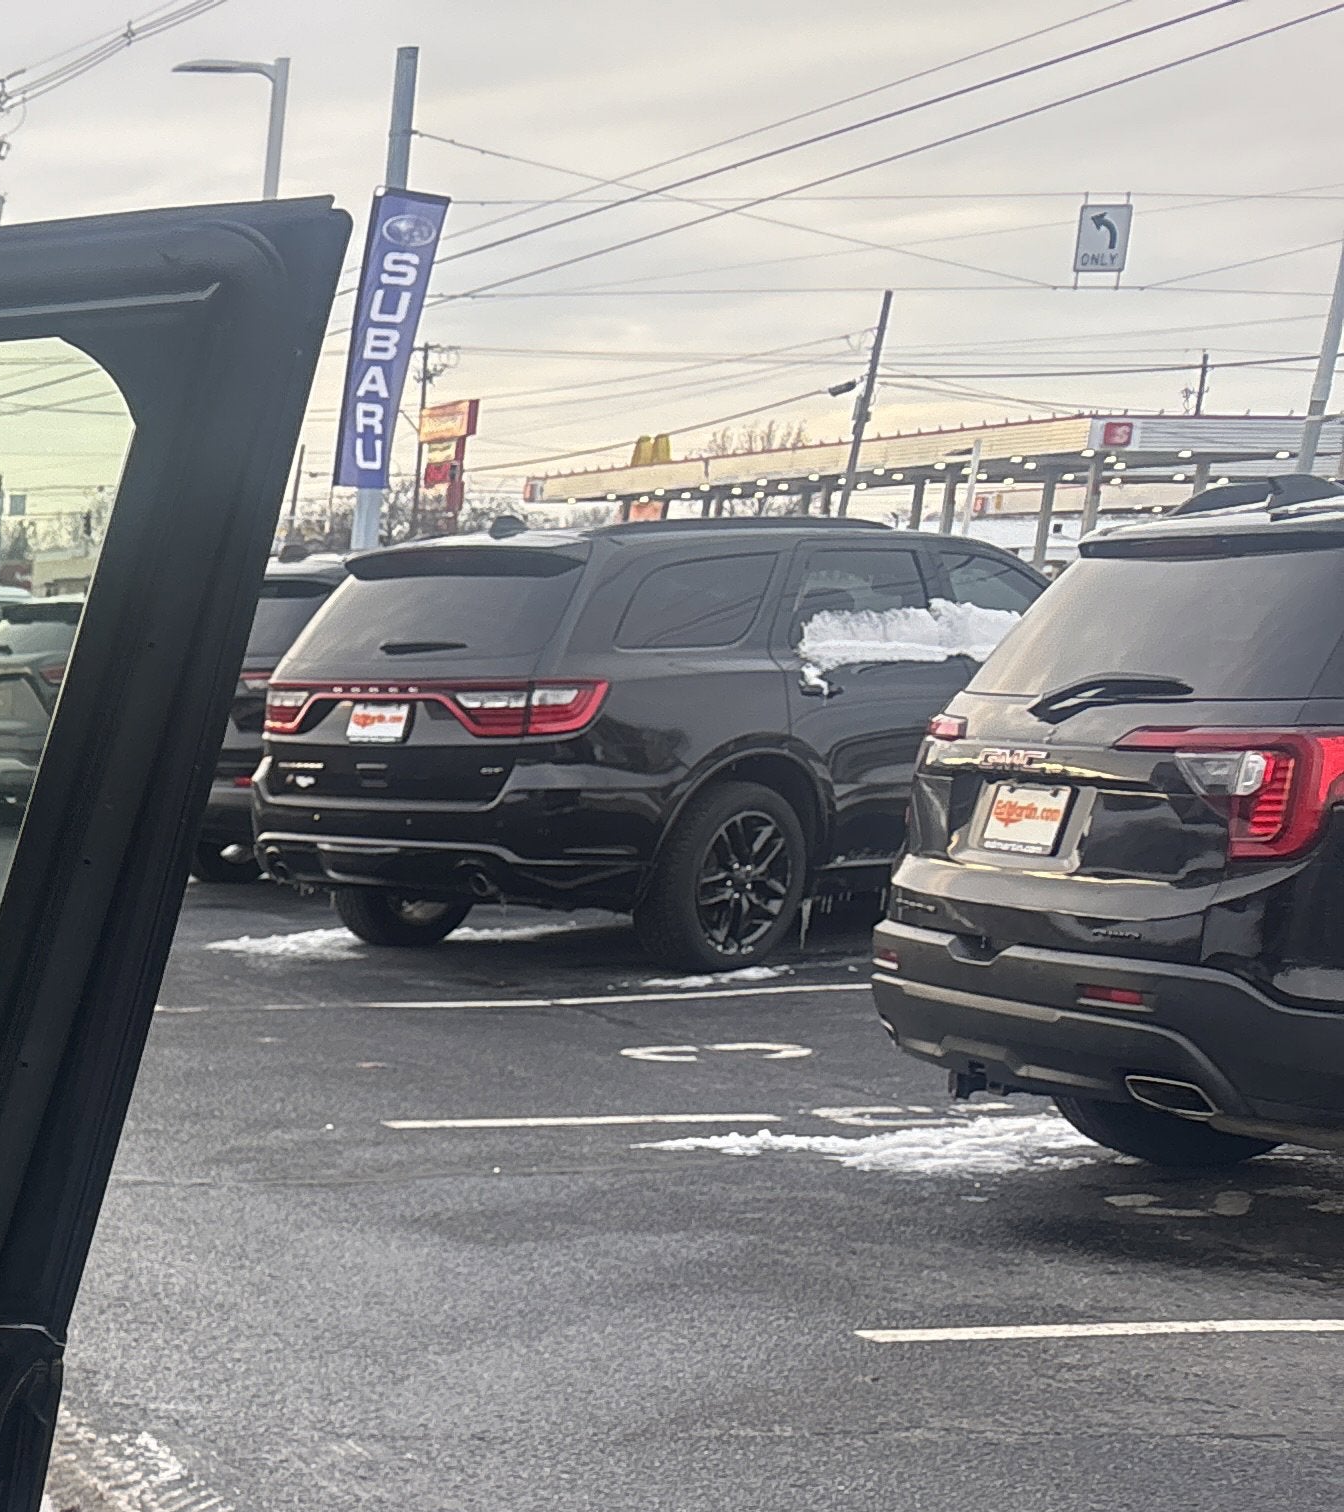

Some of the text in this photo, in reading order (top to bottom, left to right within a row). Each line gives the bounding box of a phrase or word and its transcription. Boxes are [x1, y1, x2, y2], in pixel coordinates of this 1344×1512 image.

[1080, 252, 1119, 267] ONLY
[355, 251, 420, 470] SUBARU
[978, 748, 1051, 773] GMC
